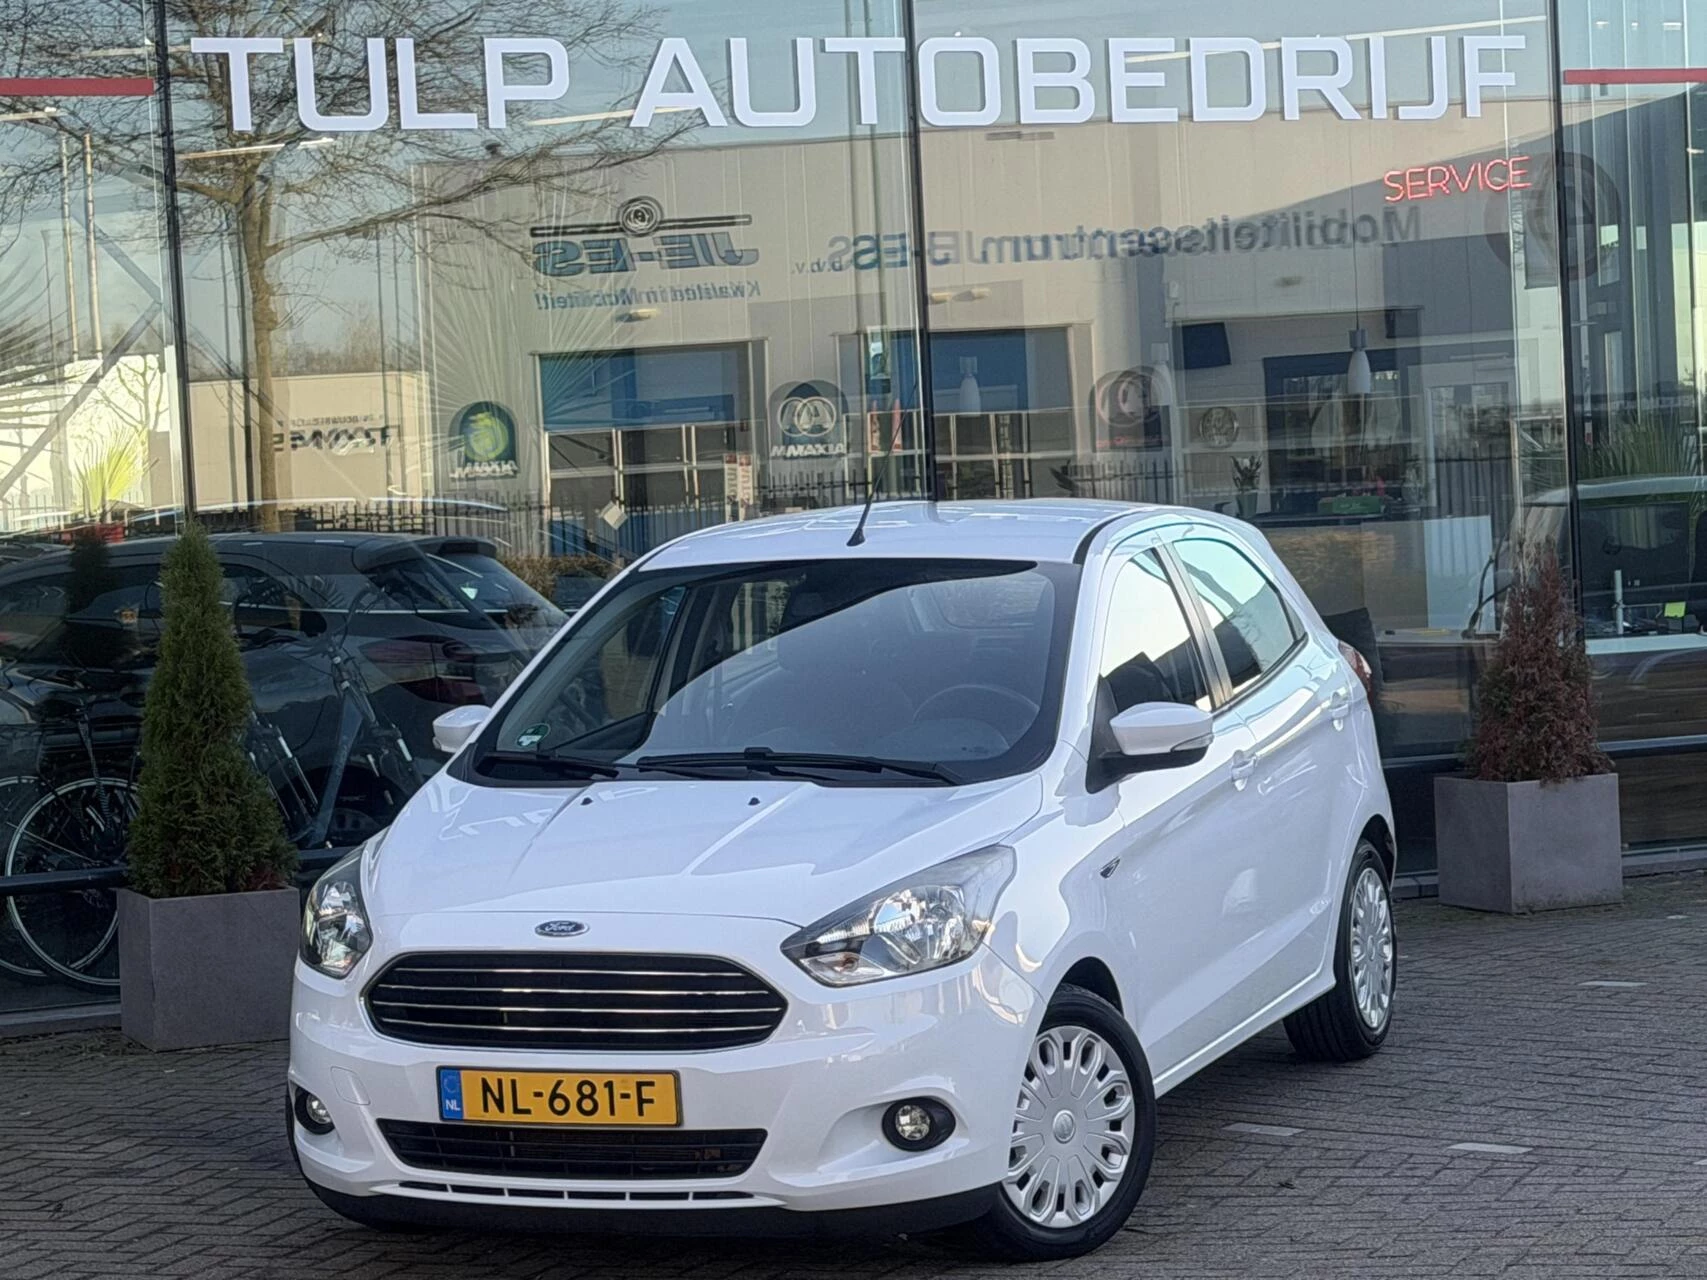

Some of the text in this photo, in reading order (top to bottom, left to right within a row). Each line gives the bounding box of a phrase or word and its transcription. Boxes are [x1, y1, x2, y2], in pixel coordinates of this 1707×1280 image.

[190, 34, 1528, 132] TULP AUTOBEDRIJF
[1384, 156, 1532, 202] SERVICE
[445, 1099, 461, 1111] NL
[481, 1077, 655, 1117] NL-681-F
